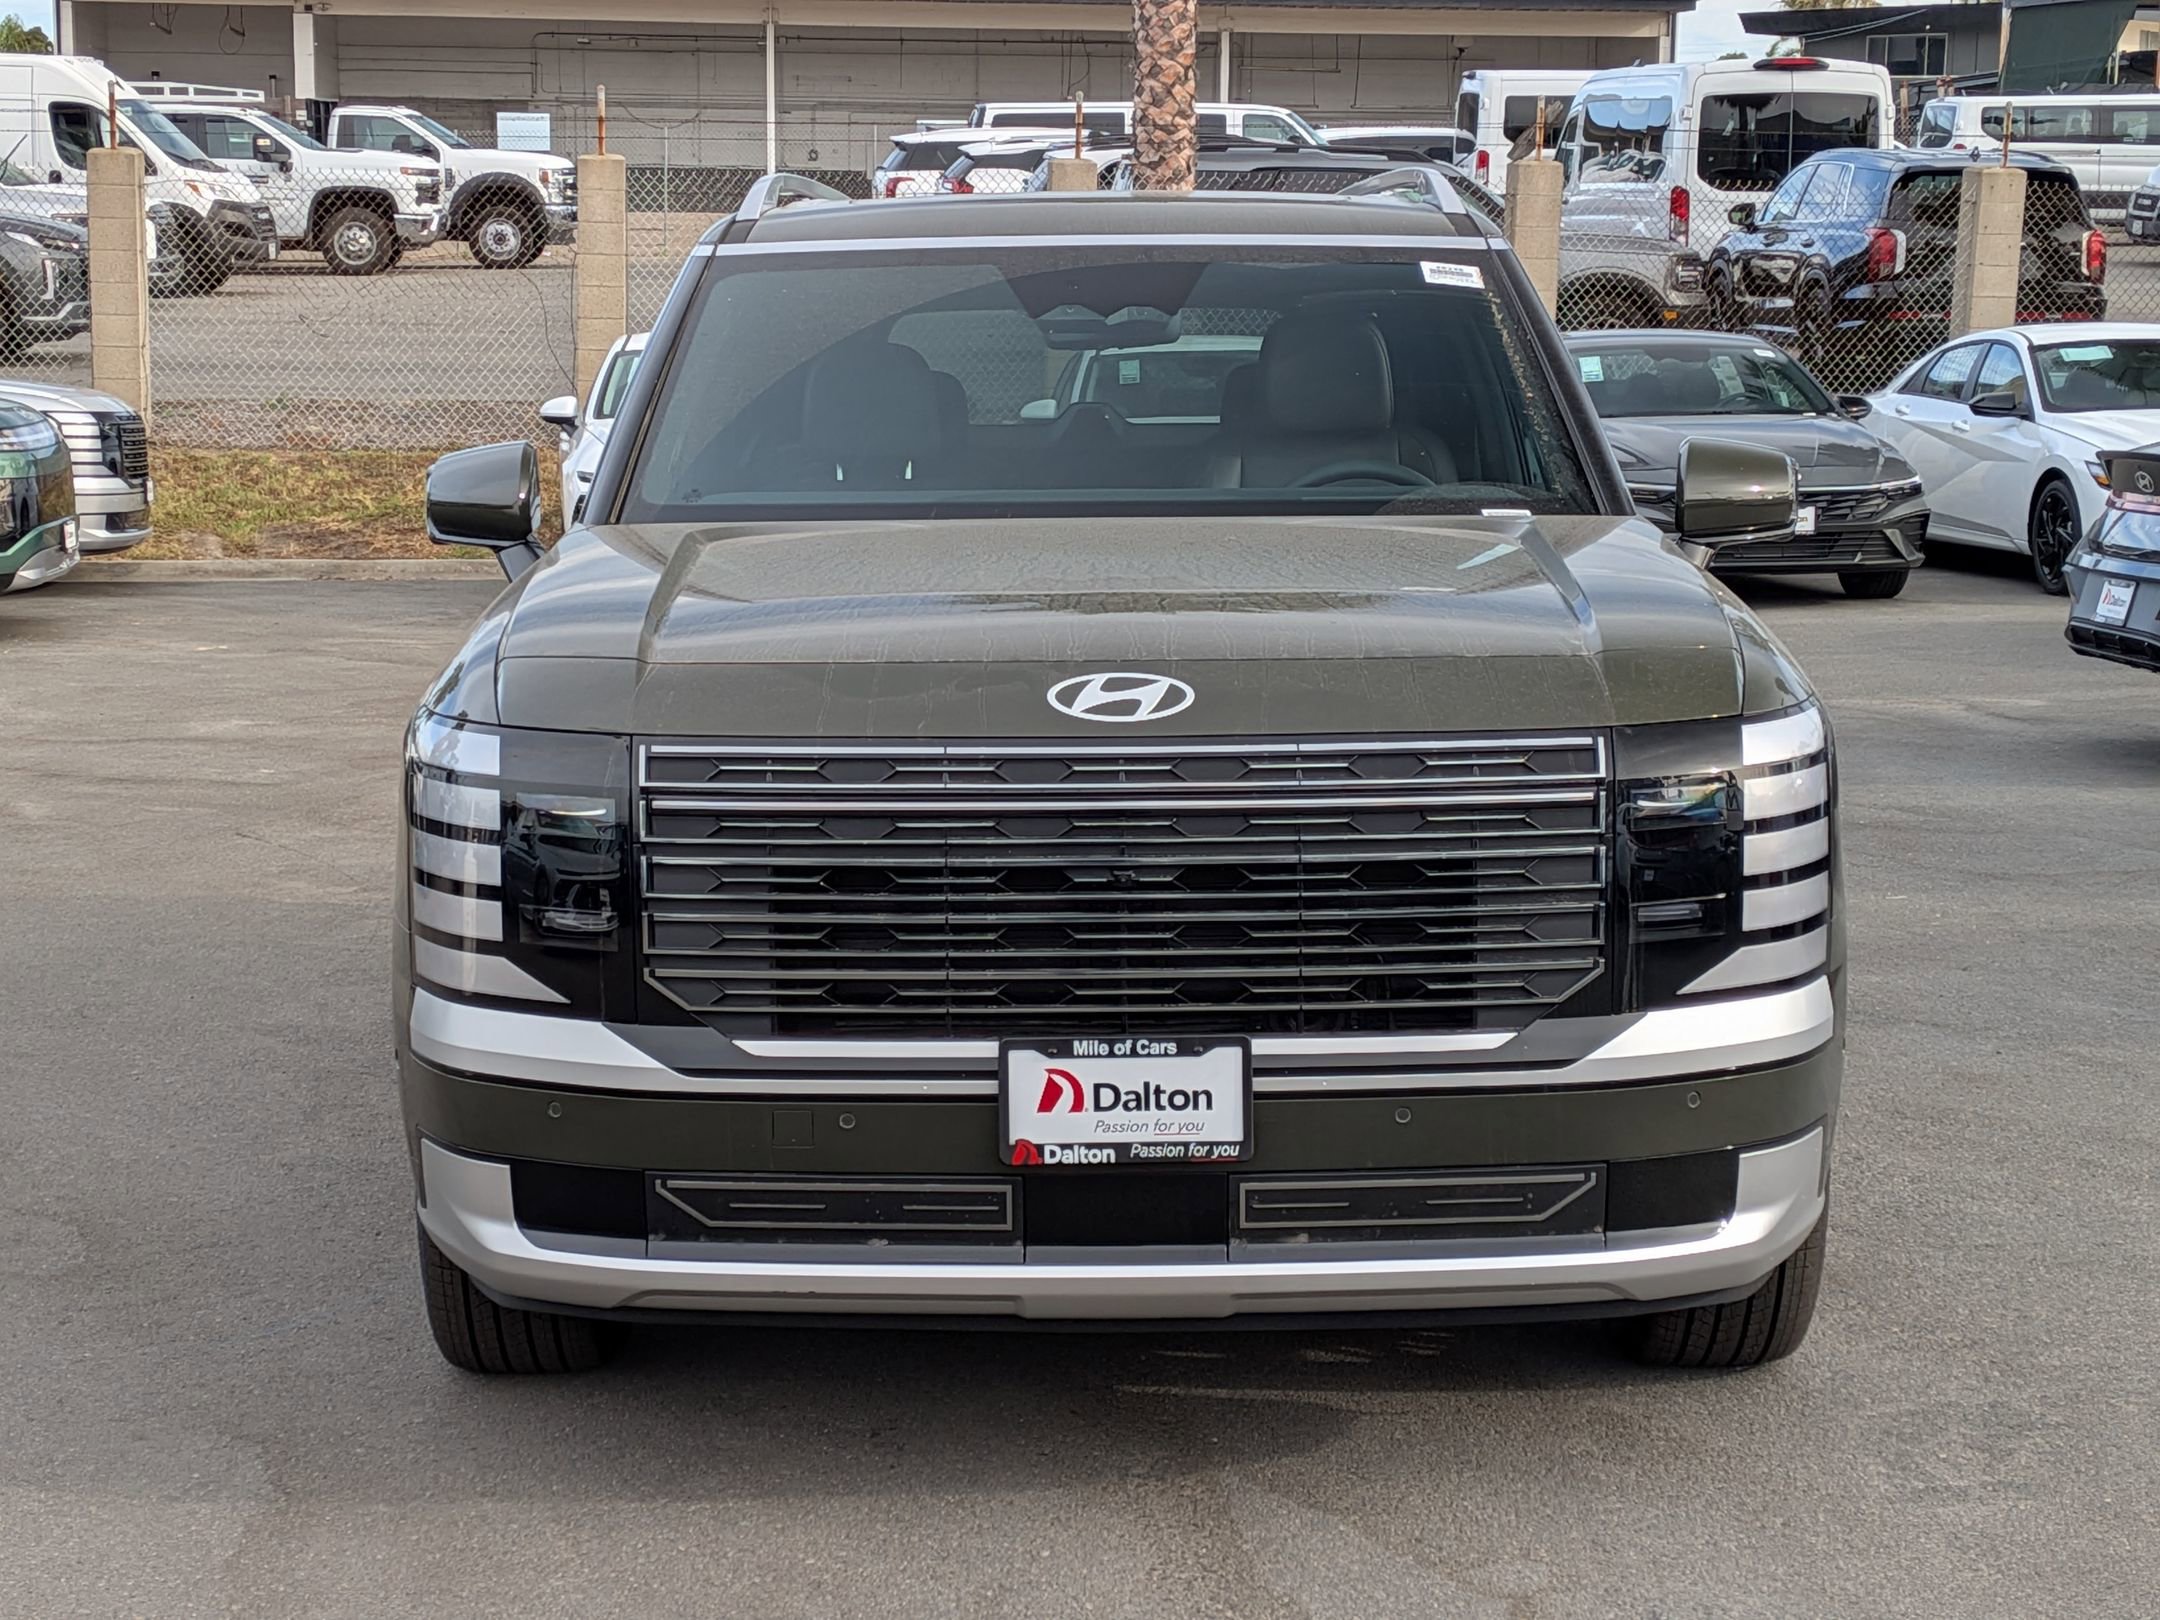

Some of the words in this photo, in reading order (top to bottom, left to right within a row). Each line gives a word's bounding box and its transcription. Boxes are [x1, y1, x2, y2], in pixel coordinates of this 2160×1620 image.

[1073, 1040, 1109, 1056] Mile
[1114, 1039, 1133, 1055] of
[1136, 1040, 1177, 1055] Cars
[1093, 1081, 1213, 1112] Dalton
[1094, 1120, 1149, 1133] Passion
[1153, 1119, 1175, 1132] for
[1177, 1122, 1205, 1134] you
[1044, 1144, 1116, 1164] Dalton
[1130, 1144, 1185, 1158] Passion
[1187, 1143, 1210, 1157] for
[1210, 1145, 1240, 1159] you
